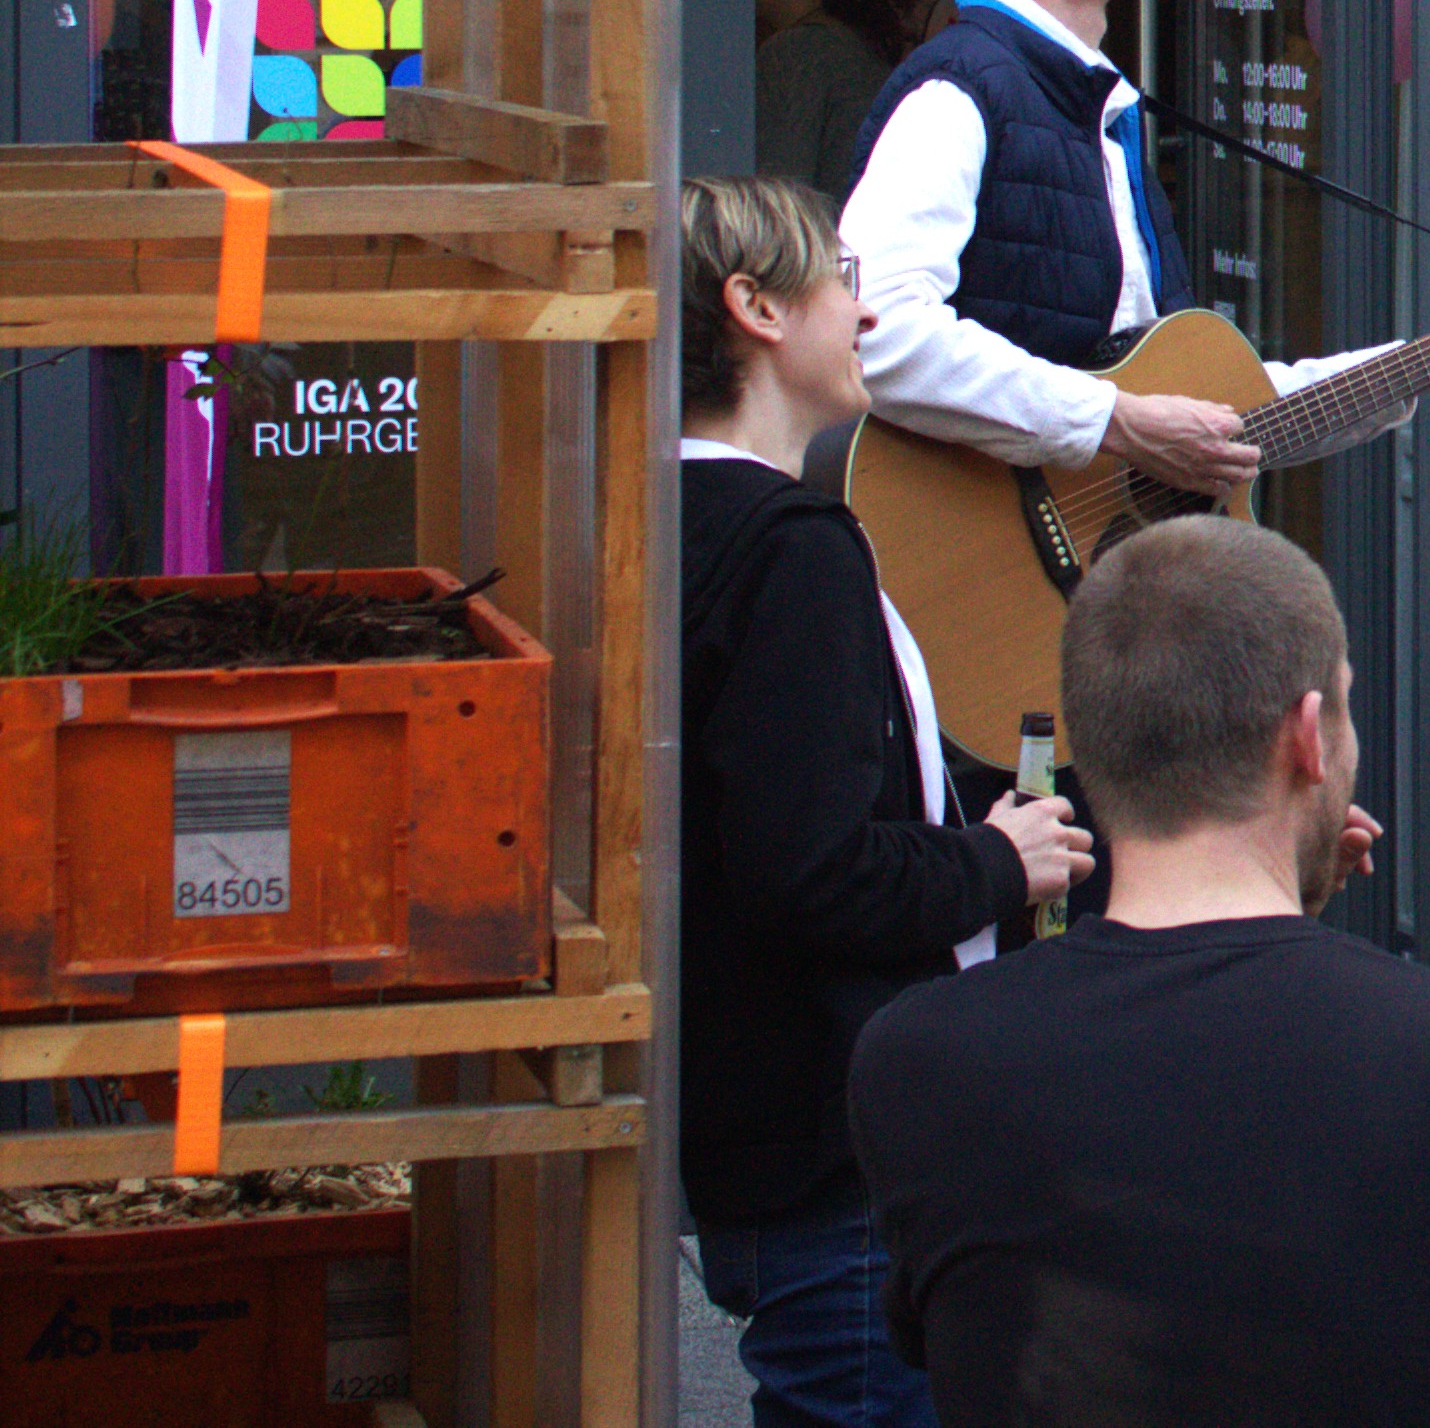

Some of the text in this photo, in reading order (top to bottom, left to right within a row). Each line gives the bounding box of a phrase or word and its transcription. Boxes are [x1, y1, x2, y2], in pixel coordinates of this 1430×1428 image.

[1291, 65, 1307, 90] Uhr
[1291, 104, 1307, 130] Uhr
[1289, 143, 1306, 169] Uhr
[295, 378, 370, 415] IGA
[177, 876, 284, 910] 84505
